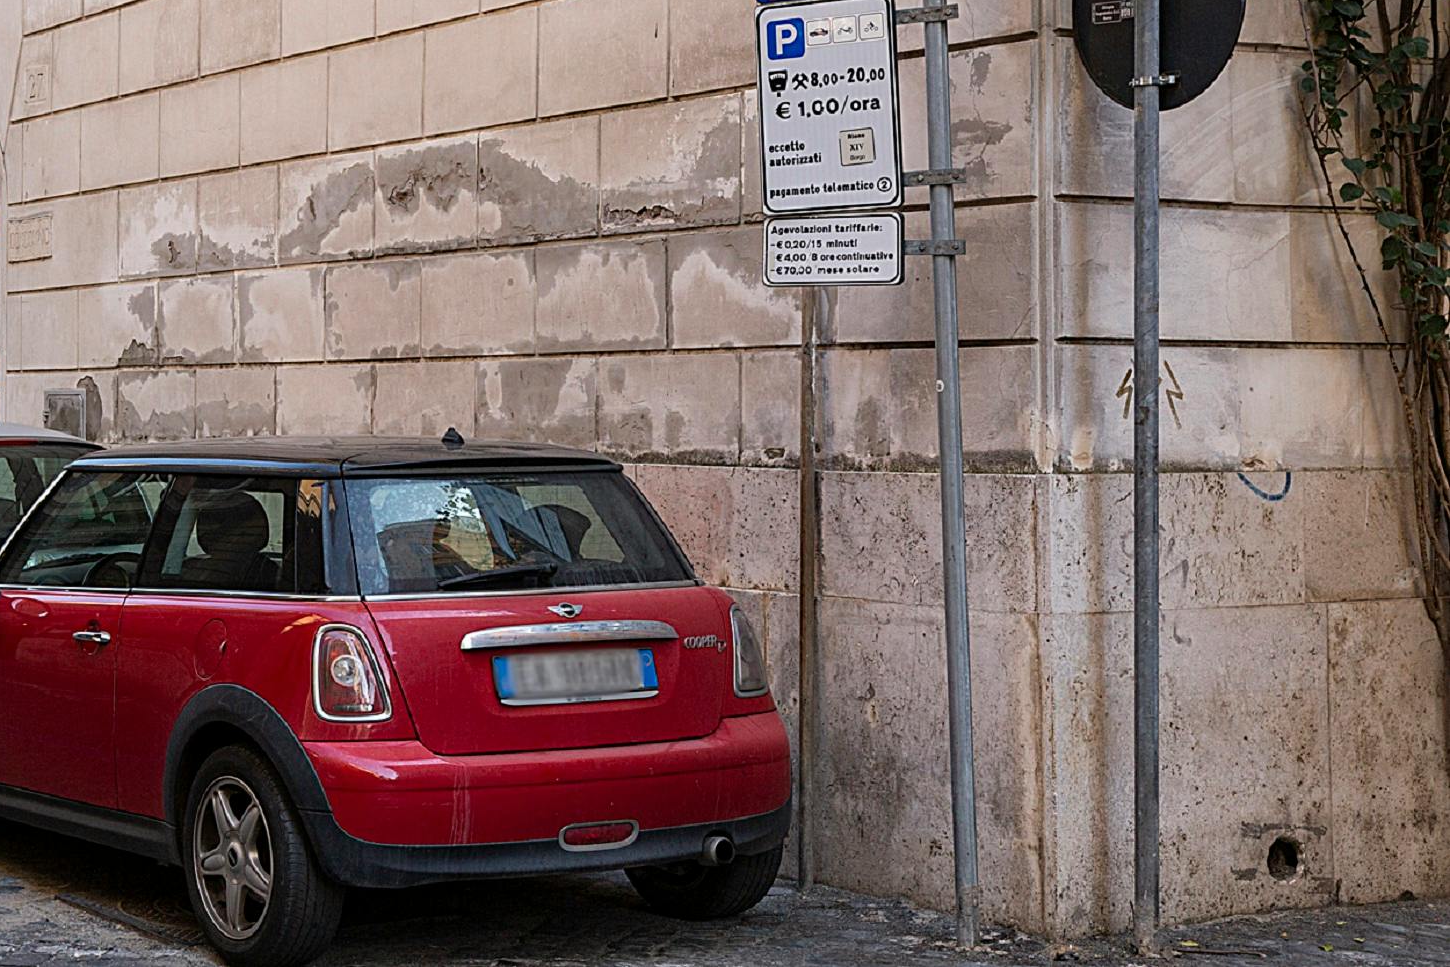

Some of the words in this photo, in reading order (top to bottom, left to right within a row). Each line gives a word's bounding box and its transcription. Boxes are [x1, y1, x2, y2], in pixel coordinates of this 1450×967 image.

[775, 23, 798, 55] P
[769, 140, 805, 153] eccetto
[769, 152, 822, 167] autorizzati
[769, 184, 820, 199] pagamento
[823, 180, 874, 193] telematico
[771, 224, 832, 235] Agevolazioni
[835, 223, 883, 233] tariffarie:
[826, 239, 858, 248] minuti
[820, 254, 835, 262] ore
[836, 251, 894, 262] continuative
[846, 265, 880, 274] solare
[683, 634, 717, 649] COOPER
